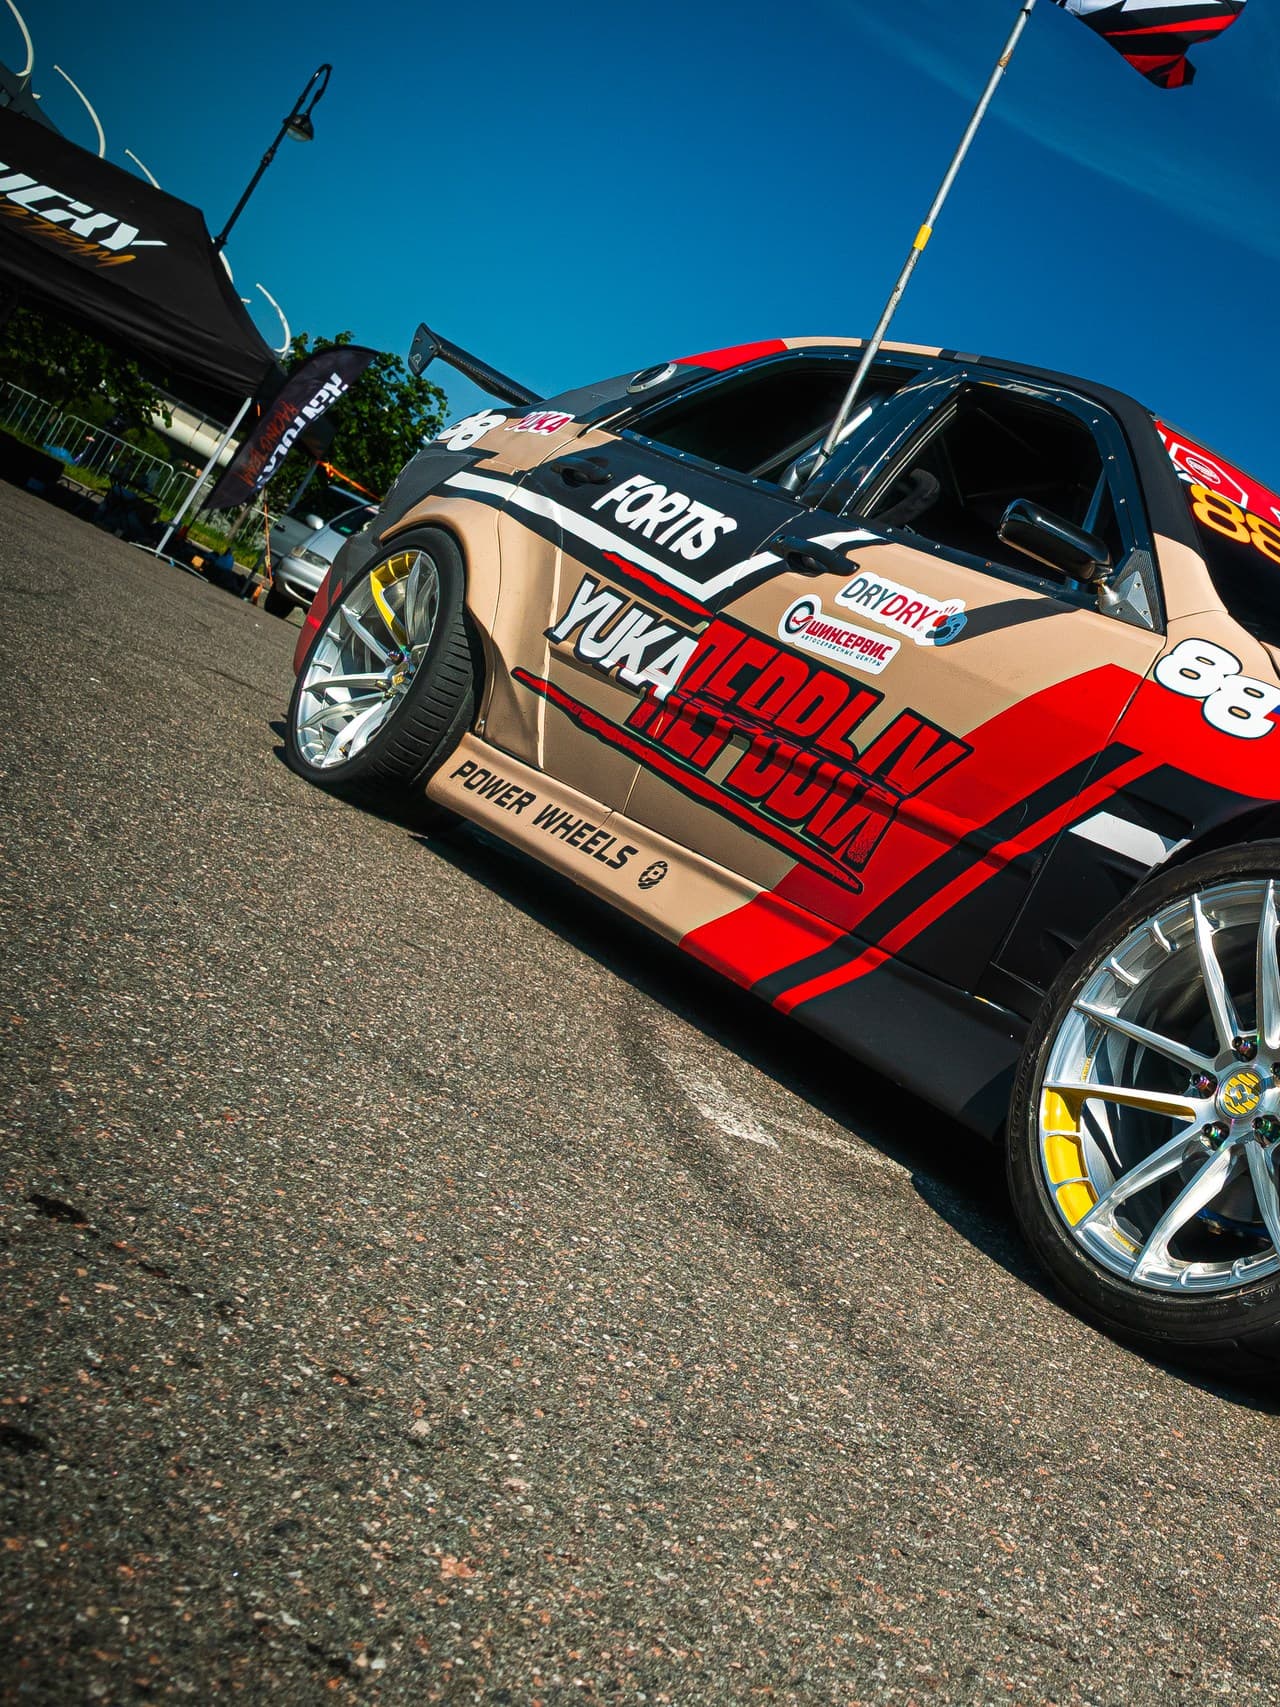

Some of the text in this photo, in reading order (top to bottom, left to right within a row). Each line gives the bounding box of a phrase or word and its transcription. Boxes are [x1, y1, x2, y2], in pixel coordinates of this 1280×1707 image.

[548, 576, 701, 699] YUKA
[805, 619, 894, 661] ШИНСЕРВИС
[855, 653, 883, 667] ЦЕНТРЫ
[450, 759, 639, 870] POWER WHEELS
